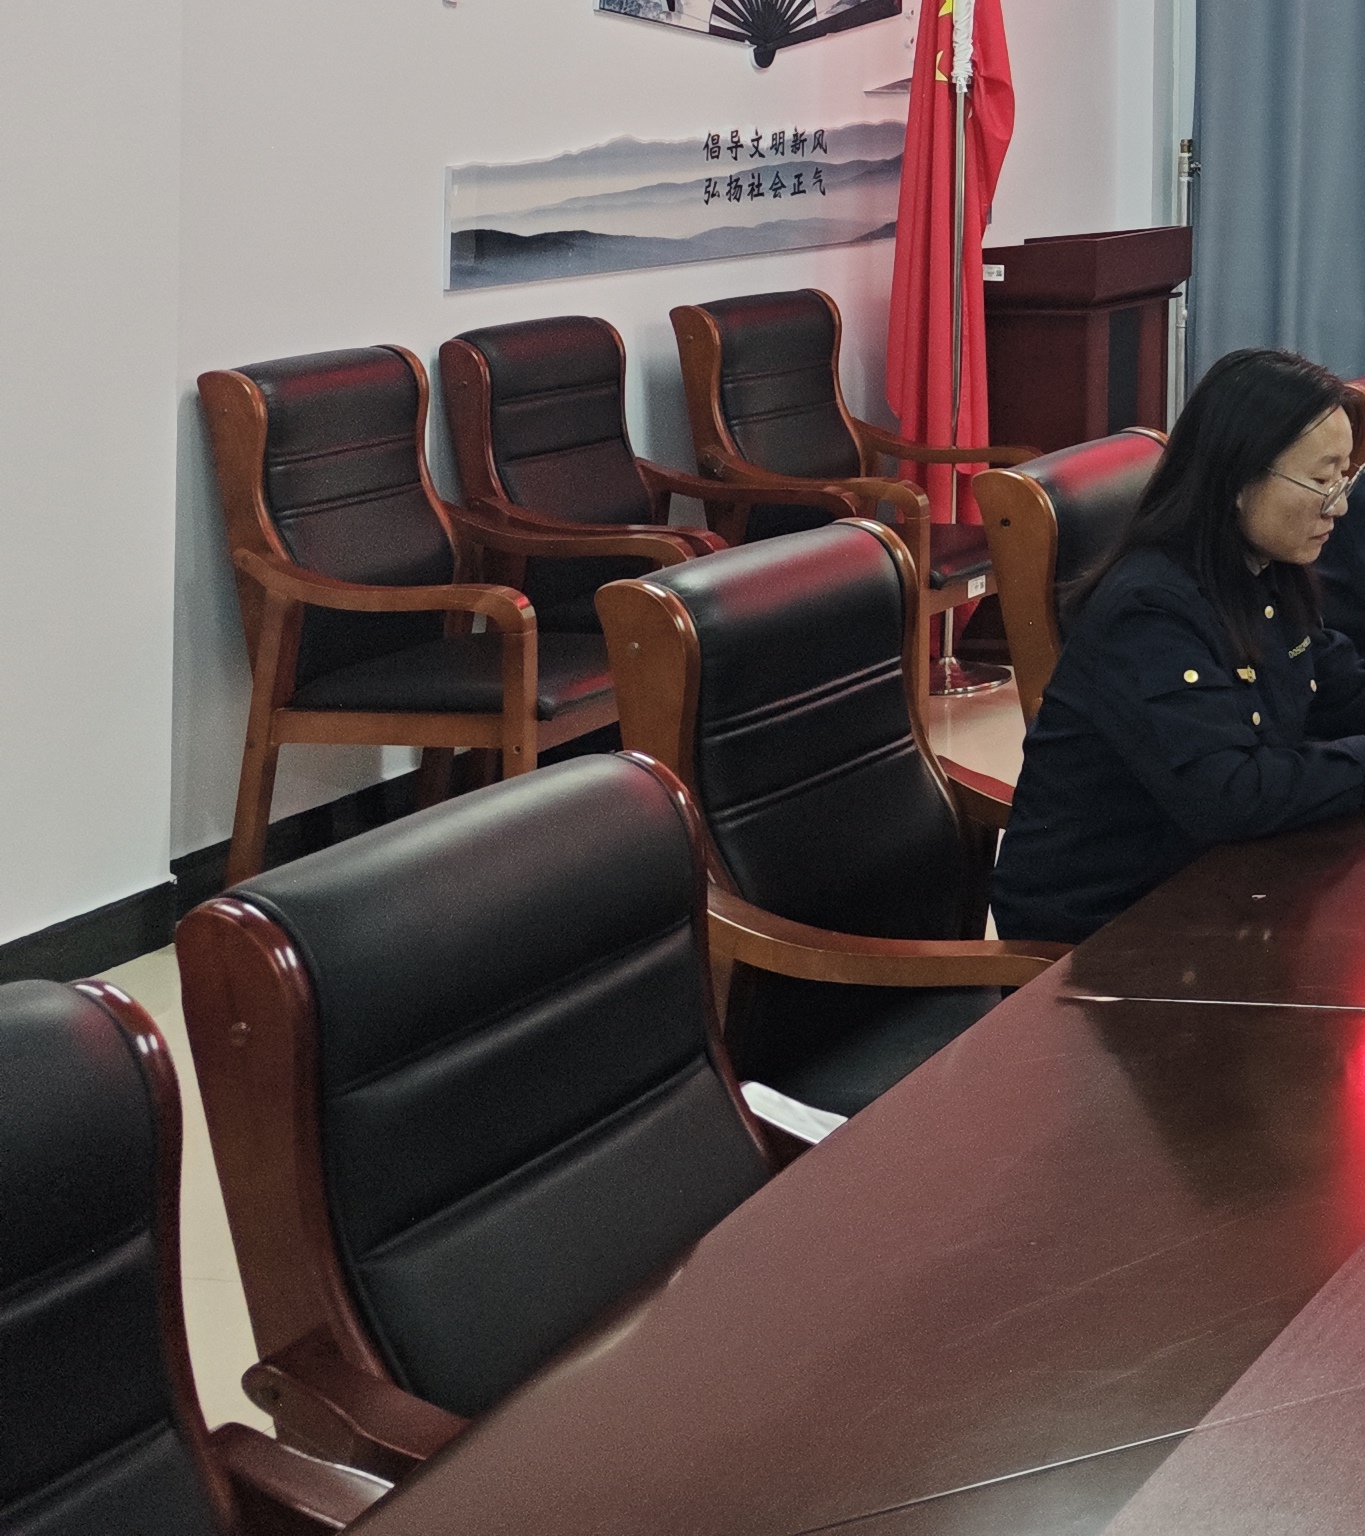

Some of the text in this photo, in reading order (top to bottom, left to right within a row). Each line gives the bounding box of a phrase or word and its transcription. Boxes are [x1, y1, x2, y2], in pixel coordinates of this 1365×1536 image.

[702, 125, 828, 162] 倡导文明新风
[703, 166, 827, 206] 弘扬社会正气
